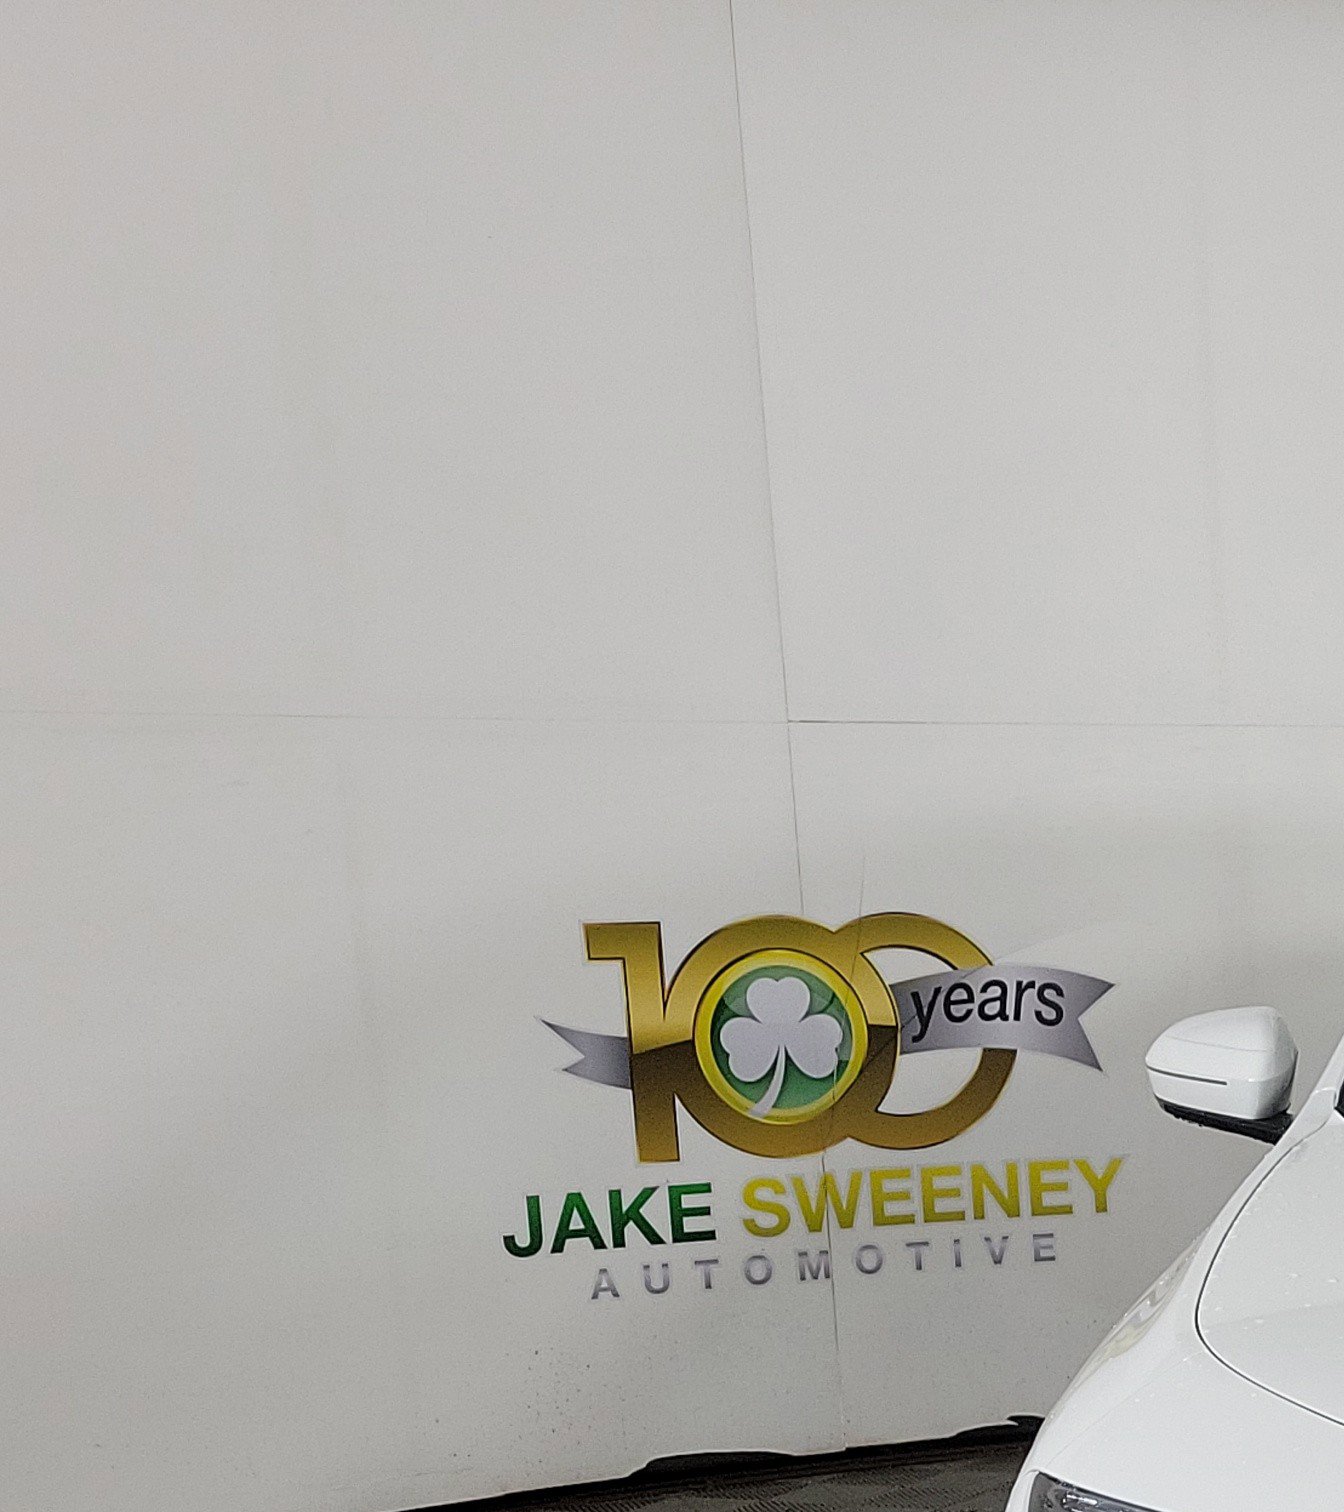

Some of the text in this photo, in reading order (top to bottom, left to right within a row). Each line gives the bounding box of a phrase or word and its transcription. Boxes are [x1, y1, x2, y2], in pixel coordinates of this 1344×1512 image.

[582, 912, 1017, 1164] 100
[910, 979, 1065, 1043] years
[502, 1157, 1122, 1258] JAKE SWEENEY
[591, 1233, 1056, 1300] AUTOMOTIVE
